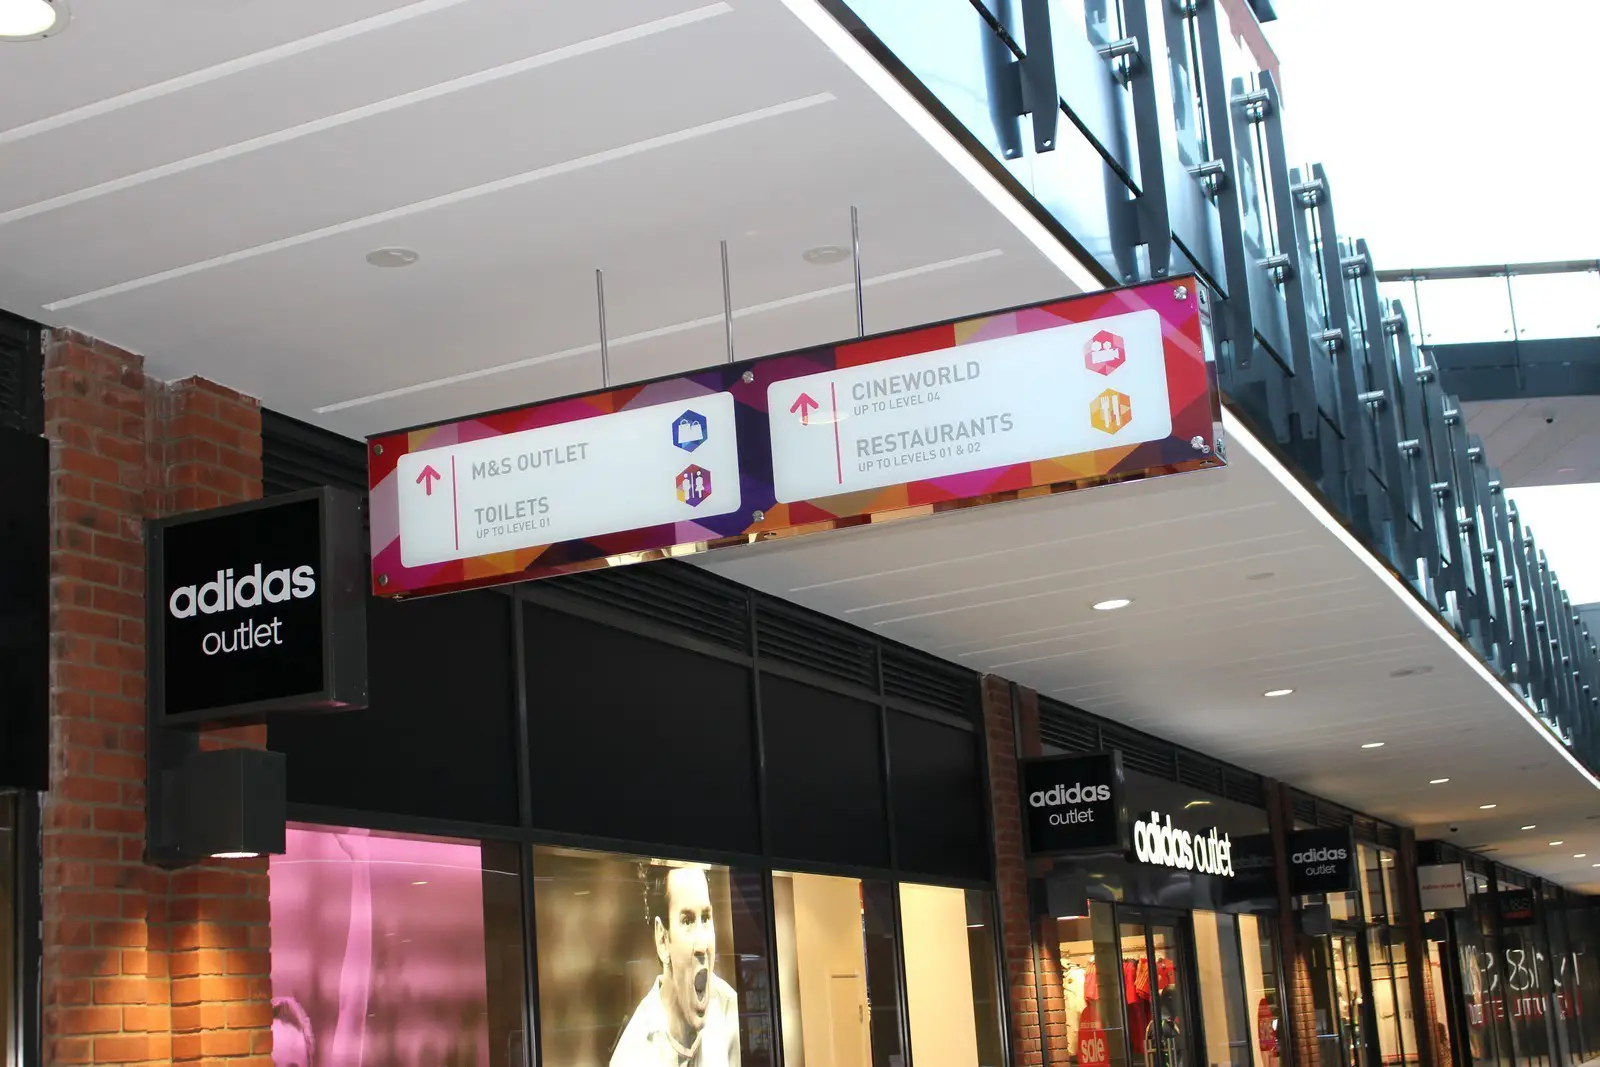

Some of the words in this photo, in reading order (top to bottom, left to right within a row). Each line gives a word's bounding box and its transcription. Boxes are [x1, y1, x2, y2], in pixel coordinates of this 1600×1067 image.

[852, 361, 980, 401] CINEWORLD
[854, 404, 870, 416] UP
[873, 401, 886, 412] TO
[889, 394, 924, 410] LEVEL
[928, 392, 940, 403] 04
[857, 413, 1013, 458] RESTAURANTS
[472, 456, 512, 480] M&S
[518, 442, 588, 472] OUTLET
[858, 460, 873, 472] UP
[876, 457, 890, 469] TO
[893, 449, 936, 467] LEVELS
[939, 446, 951, 458] 01
[956, 445, 965, 456] &
[967, 442, 981, 454] 02
[475, 497, 550, 525] TOILETS
[476, 529, 490, 539] UP
[492, 526, 504, 536] TO
[507, 521, 537, 533] LEVEL
[540, 518, 550, 528] 01
[169, 564, 316, 618] adidas
[202, 616, 283, 656] outlet
[1029, 782, 1111, 808] adidas
[1049, 808, 1094, 826] outlet
[1134, 811, 1193, 870] adidas
[1194, 826, 1235, 878] outlet
[1292, 847, 1348, 864] adidas
[1306, 864, 1336, 876] outlet
[1081, 1031, 1104, 1063] sale
